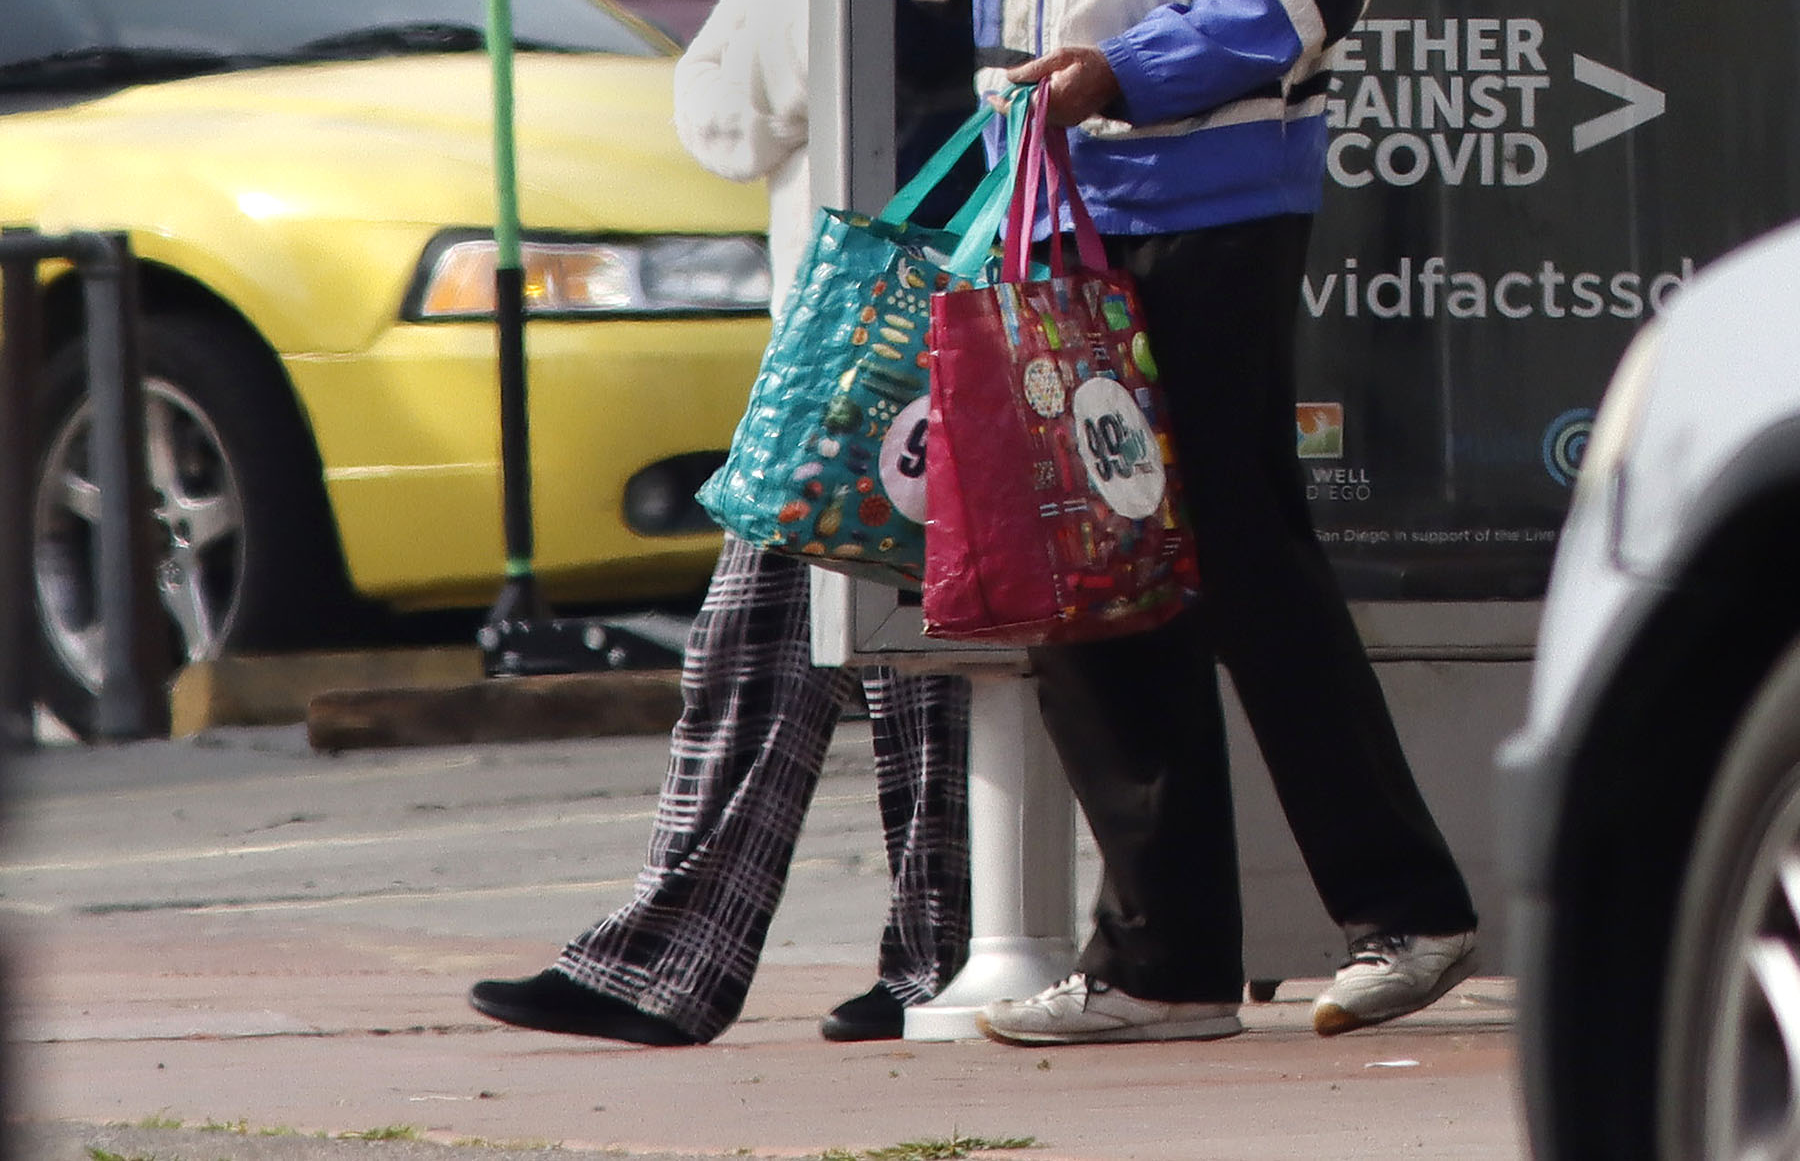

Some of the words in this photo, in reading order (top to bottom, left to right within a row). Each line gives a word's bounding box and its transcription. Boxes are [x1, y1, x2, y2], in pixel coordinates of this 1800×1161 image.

[1326, 132, 1549, 188] COVID
[1311, 468, 1371, 484] WELL
[1411, 528, 1470, 545] support
[1474, 528, 1490, 542] of
